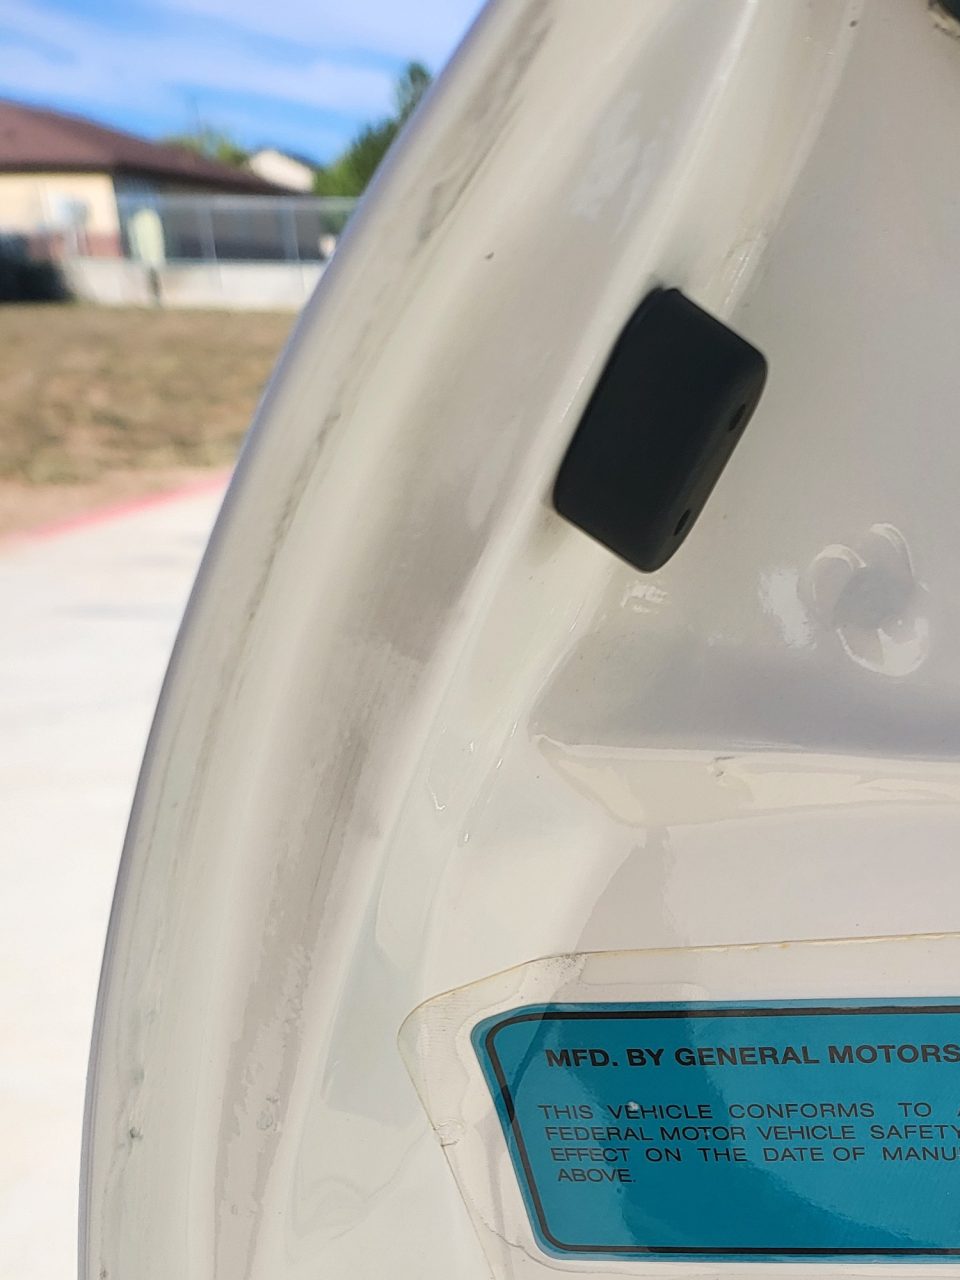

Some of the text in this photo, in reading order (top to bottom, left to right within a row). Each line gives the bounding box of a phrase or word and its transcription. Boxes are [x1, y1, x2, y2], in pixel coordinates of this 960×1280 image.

[545, 1047, 618, 1067] MFD.
[627, 1047, 665, 1067] BY
[674, 1045, 820, 1066] GENERAL
[537, 1104, 593, 1120] THIS
[607, 1104, 713, 1120] VEHICLE
[728, 1103, 875, 1119] CONFORMS
[898, 1102, 932, 1118] TO
[545, 1126, 654, 1141] FEDERAL
[660, 1126, 746, 1141] MOTOR
[756, 1125, 857, 1140] VEHICLE
[550, 1148, 630, 1162] EFFECT
[645, 1147, 682, 1162] ON
[697, 1147, 747, 1162] THE
[763, 1147, 825, 1162] DATE
[832, 1147, 865, 1162] OF
[557, 1168, 637, 1183] ABOVE.
